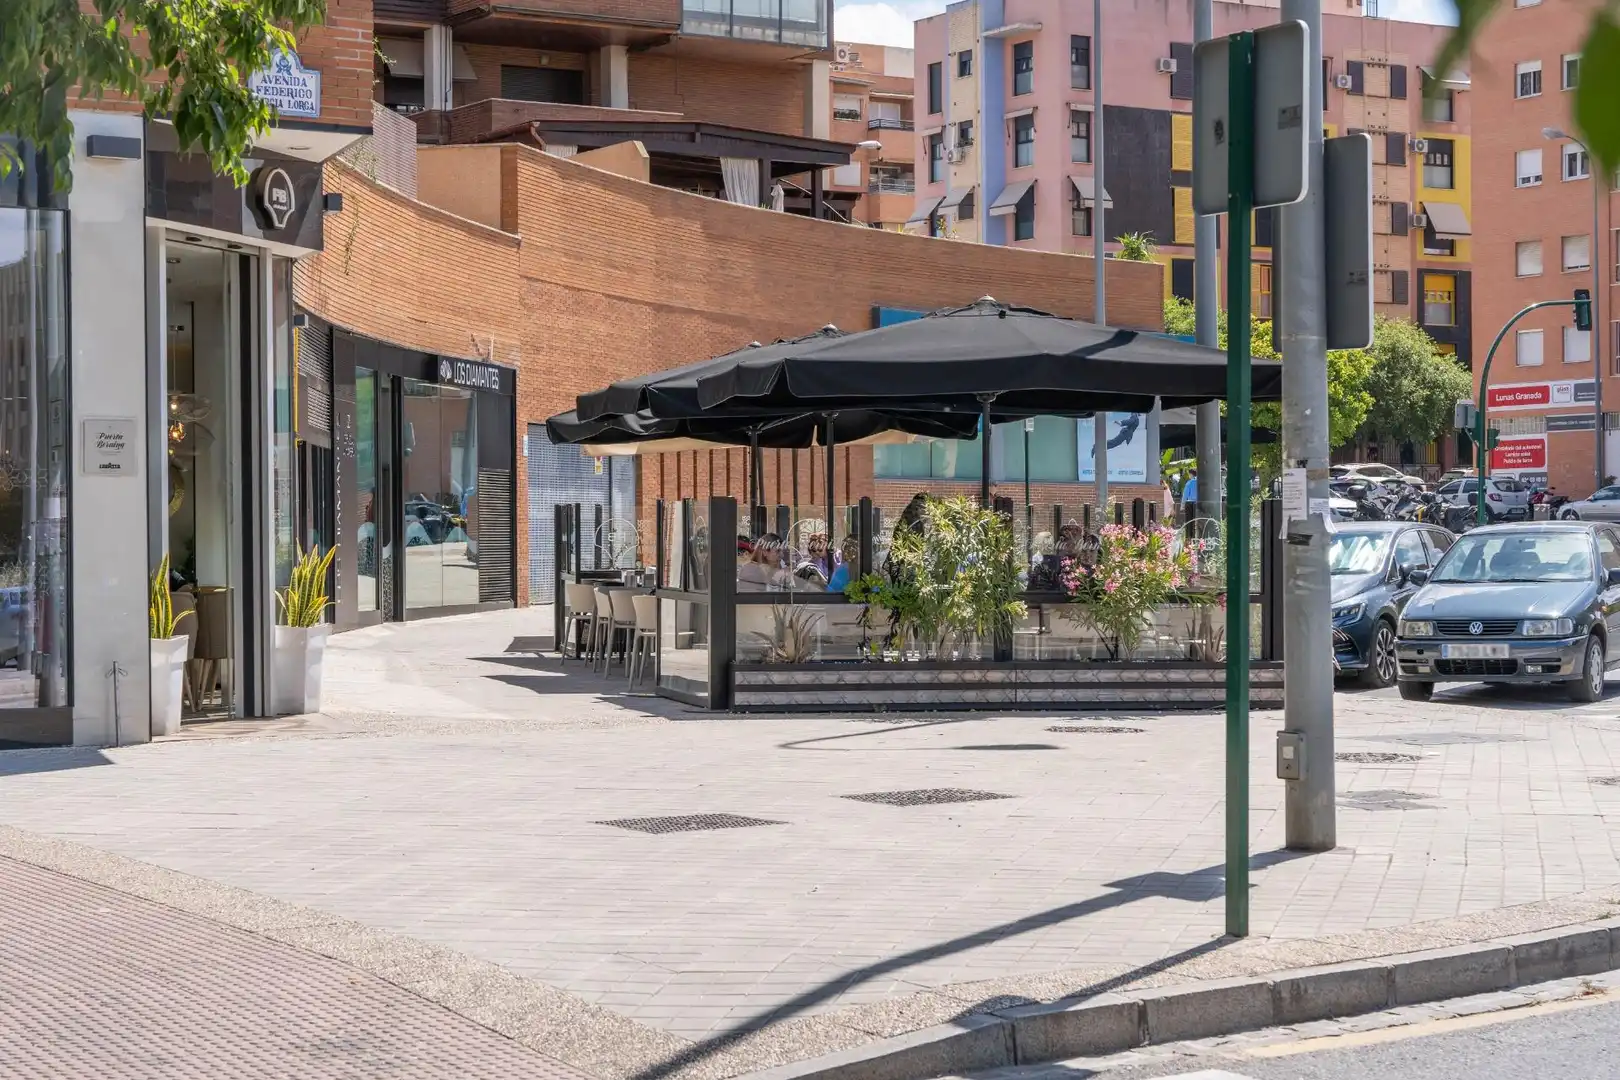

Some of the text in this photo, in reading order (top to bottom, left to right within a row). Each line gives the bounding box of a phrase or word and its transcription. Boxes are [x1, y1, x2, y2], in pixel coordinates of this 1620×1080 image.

[261, 74, 307, 88] AVENIDA
[256, 86, 313, 99] FEDERICO
[288, 100, 314, 111] LORCA
[454, 361, 499, 389] LOS DIAMANTES
[1495, 391, 1542, 402] Lunas Granada
